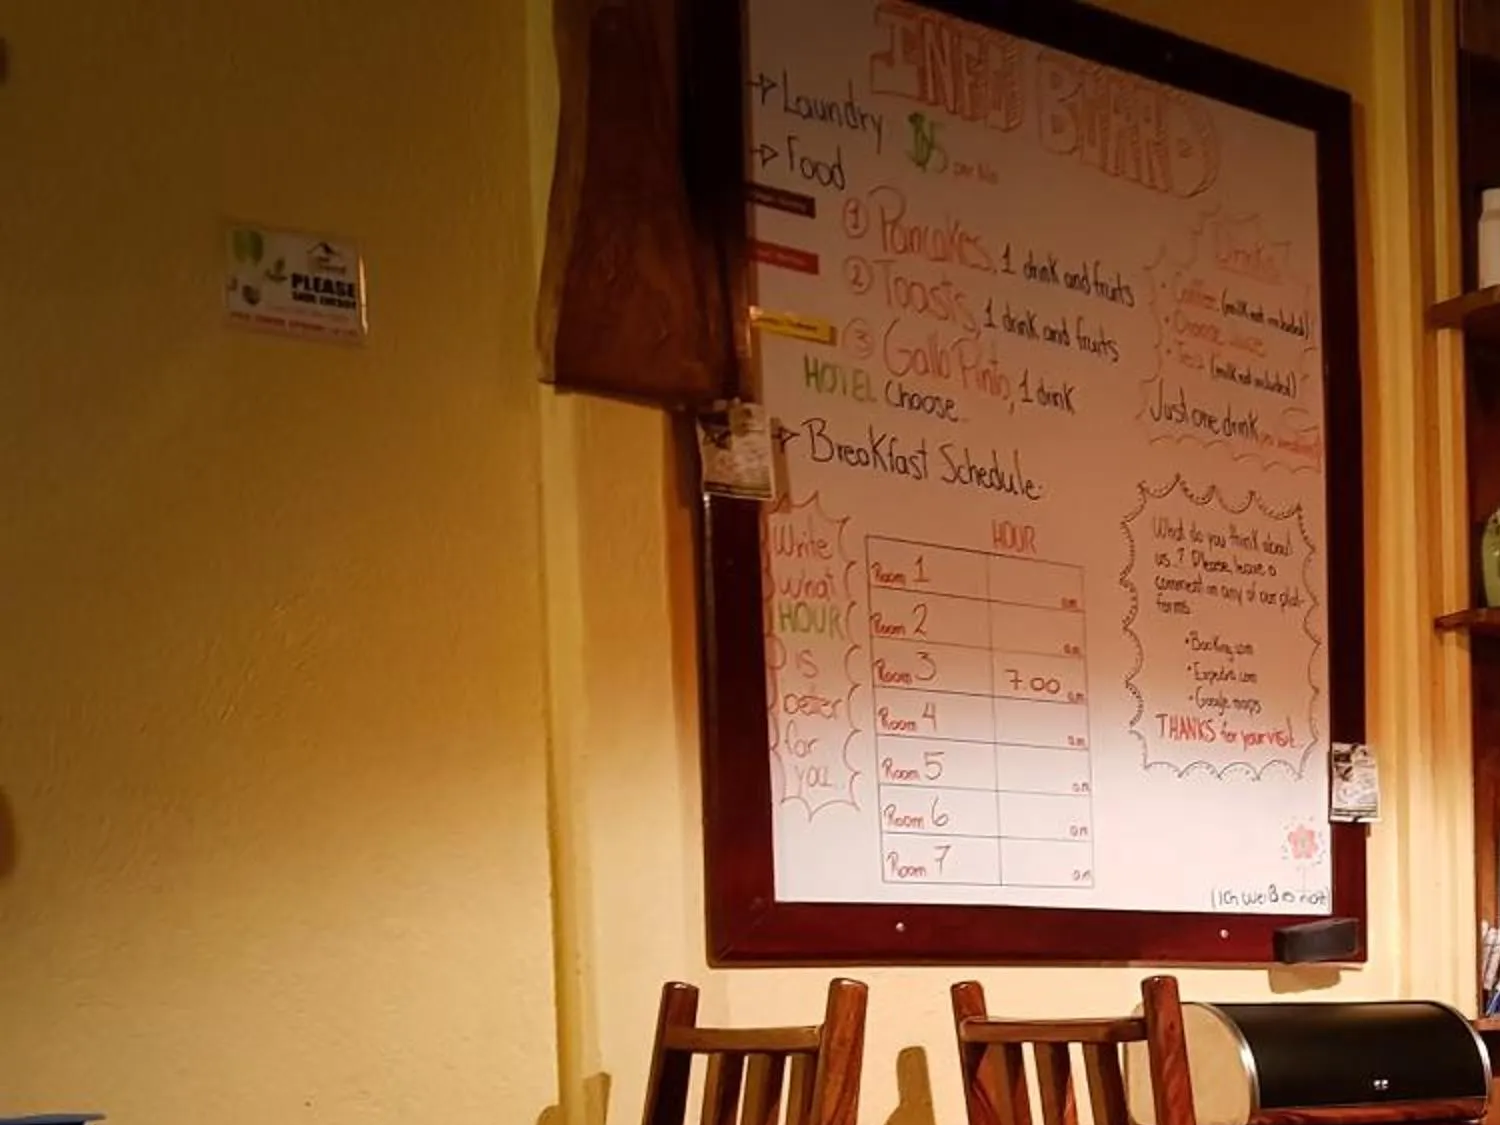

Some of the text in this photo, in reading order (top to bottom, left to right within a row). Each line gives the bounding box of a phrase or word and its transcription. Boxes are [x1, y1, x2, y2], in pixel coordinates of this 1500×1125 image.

[783, 69, 883, 155] Laundry
[787, 135, 846, 190] Food
[292, 272, 355, 298] PLEASE
[1002, 242, 1015, 275] 1
[1023, 249, 1059, 283] drink
[1063, 259, 1092, 295] and
[984, 298, 997, 328] 1
[1003, 301, 1039, 340] drink
[1043, 319, 1070, 347] and
[883, 318, 951, 379] Gallo
[1021, 367, 1033, 403] 1
[1037, 377, 1078, 416] drink
[804, 354, 960, 423] HOTEL Choose
[1149, 377, 1260, 441] Just one drink
[801, 417, 929, 481] Breakfast
[992, 519, 1037, 554] HOUR
[871, 556, 930, 587] Room 1
[778, 601, 845, 640] HOUR
[872, 604, 929, 637] Room 2
[876, 652, 937, 686] Room 3
[878, 703, 937, 732] Room 4
[1155, 713, 1217, 743] THANKS
[785, 719, 819, 758] for
[881, 751, 945, 782] Room 5
[883, 800, 949, 829] Room 6
[886, 846, 951, 880] Room 7
